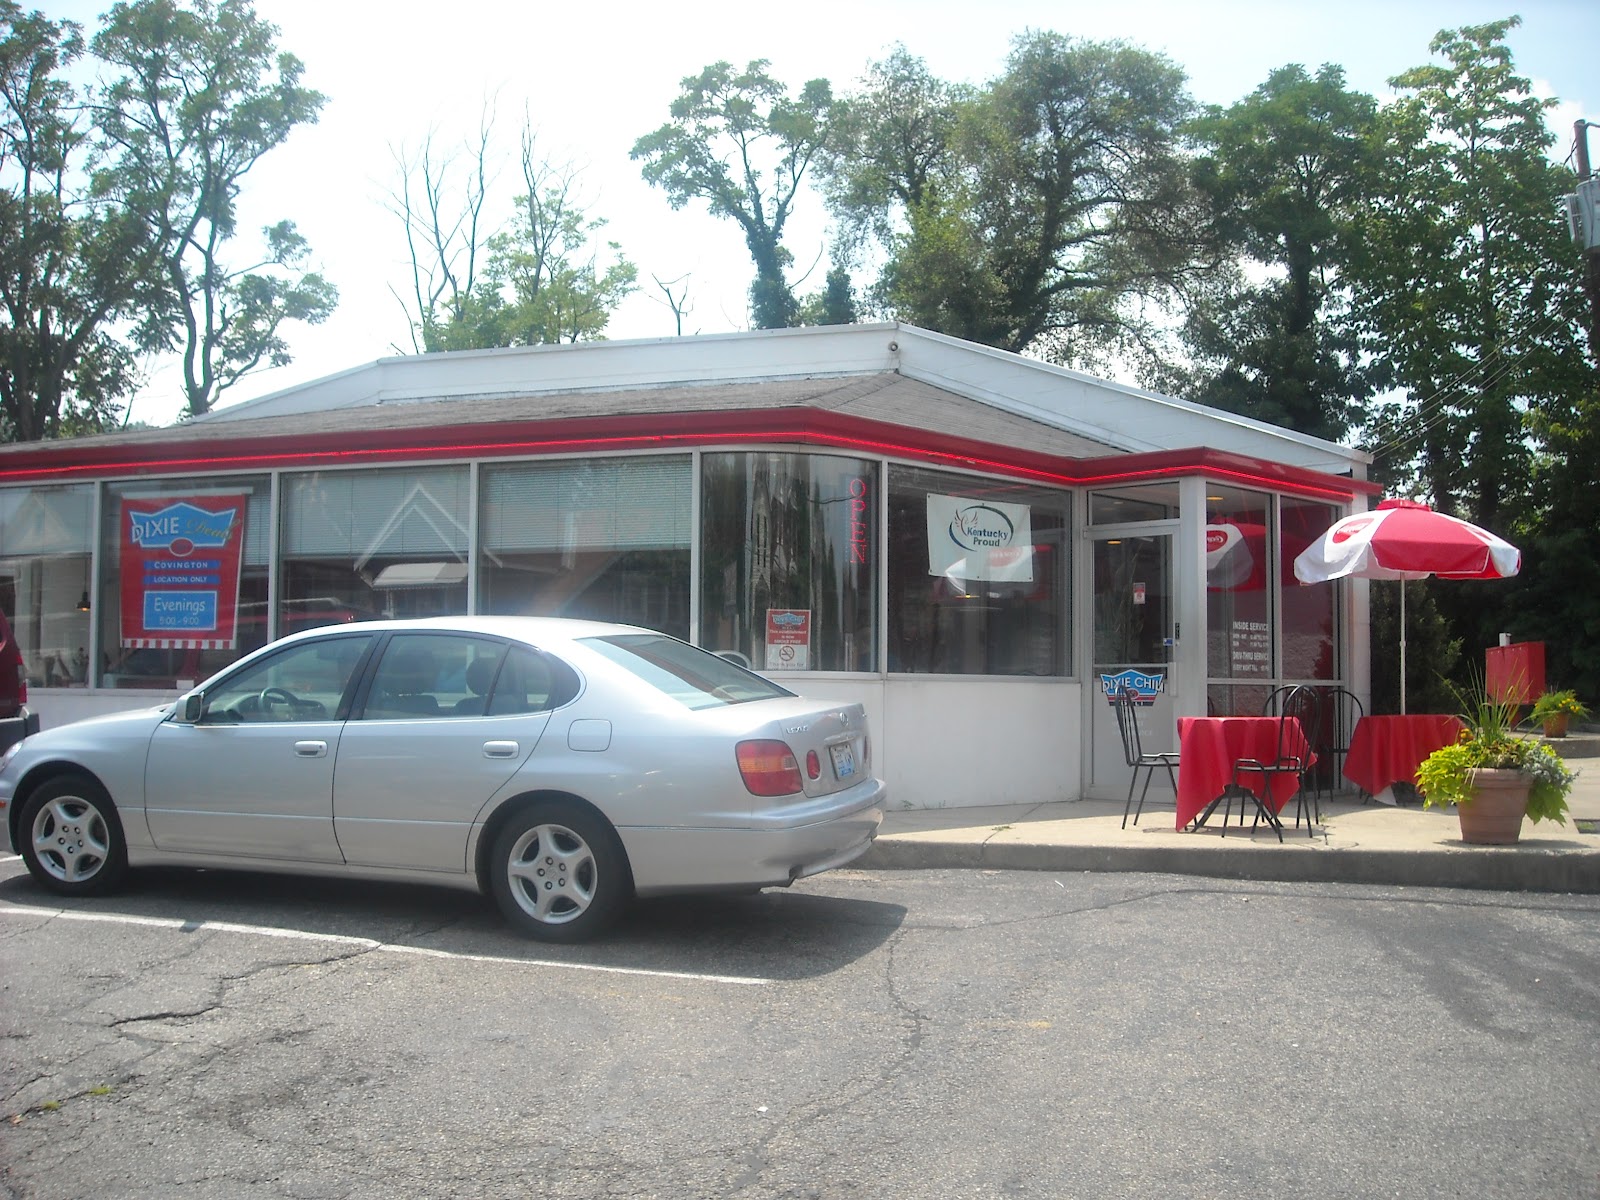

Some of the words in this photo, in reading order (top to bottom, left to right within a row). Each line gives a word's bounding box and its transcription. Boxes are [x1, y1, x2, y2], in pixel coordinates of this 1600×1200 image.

[849, 479, 867, 563] OPEN
[131, 517, 179, 543] DIXIE
[967, 526, 1009, 540] Kentucky
[973, 537, 1000, 547] Proud
[153, 576, 188, 584] LOCATION
[153, 597, 206, 616] Evenings
[183, 616, 200, 626] 9:00
[1233, 621, 1248, 630] INSIDE
[1250, 622, 1268, 631] SERVICE
[1102, 677, 1131, 692] DIXIE
